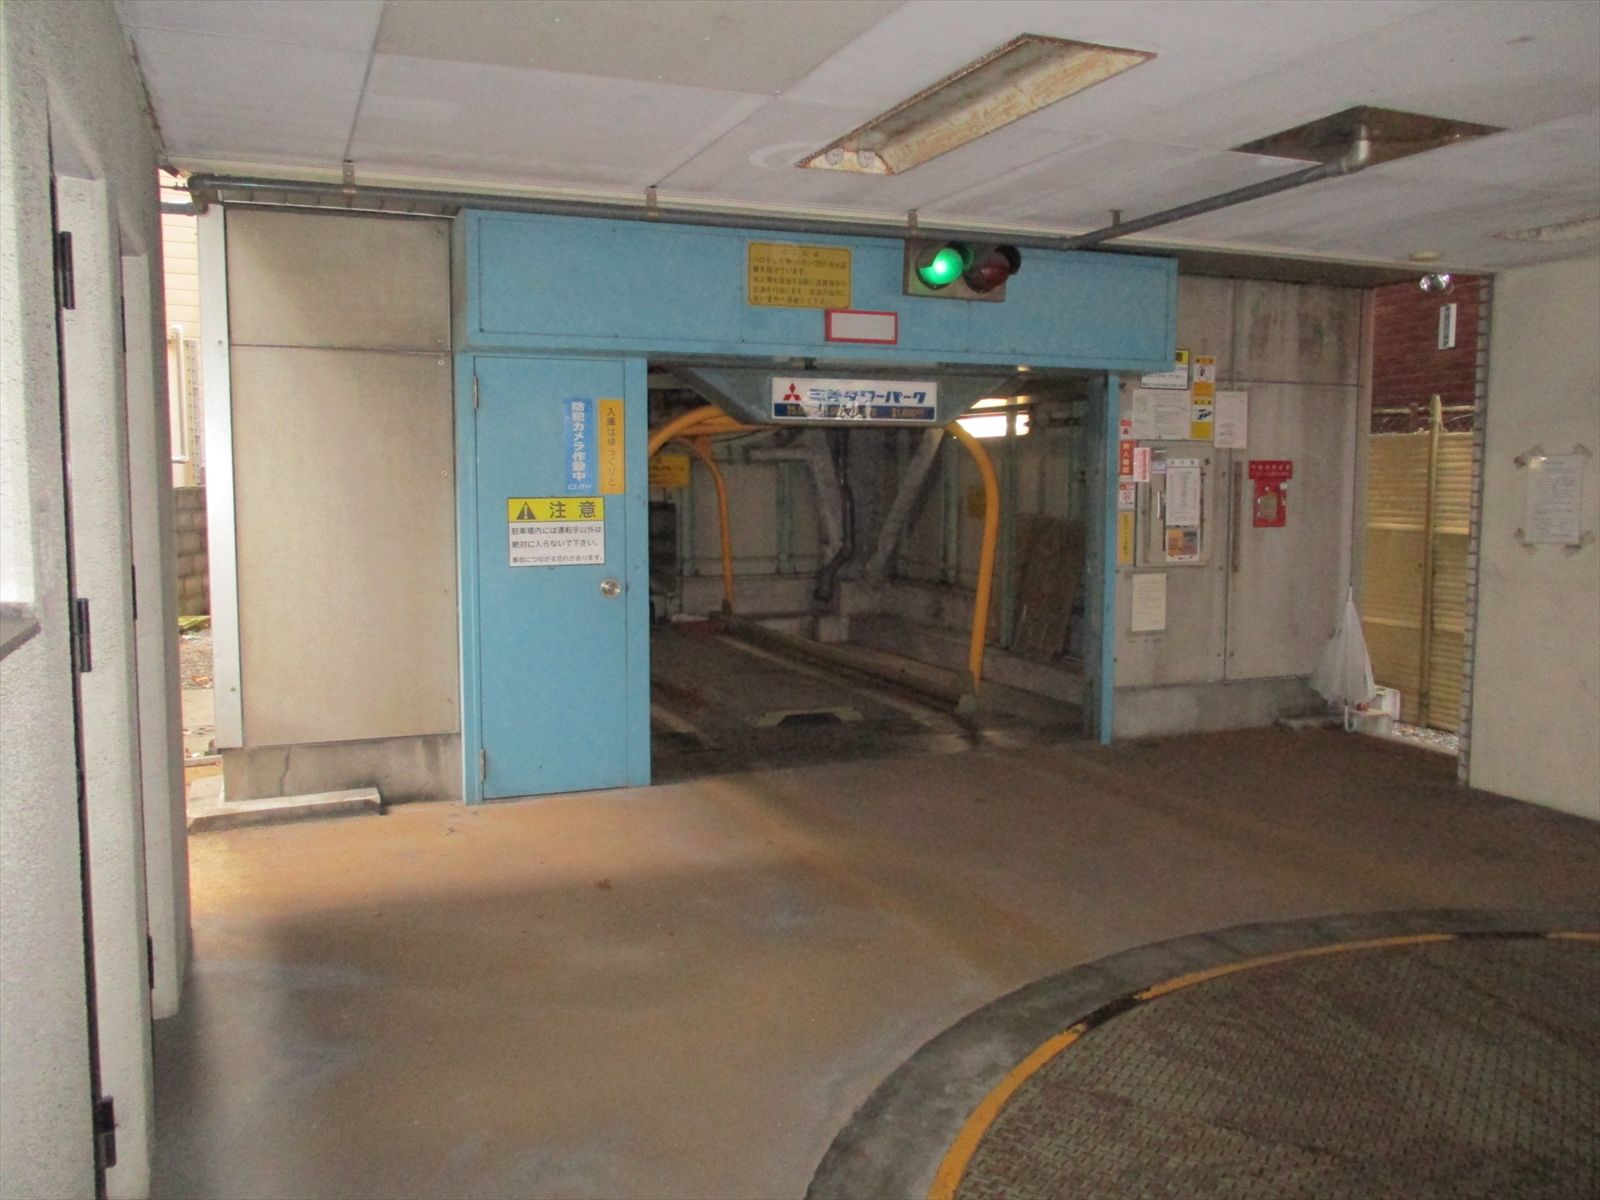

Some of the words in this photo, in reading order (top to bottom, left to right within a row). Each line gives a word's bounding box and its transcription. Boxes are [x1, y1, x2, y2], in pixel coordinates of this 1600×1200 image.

[571, 401, 586, 480] 防犯カメラ作動中
[548, 500, 597, 519] 注意
[511, 525, 602, 536] 駐車場内には運転手以外は
[511, 539, 599, 549] 絶対に入らないで下さい。
